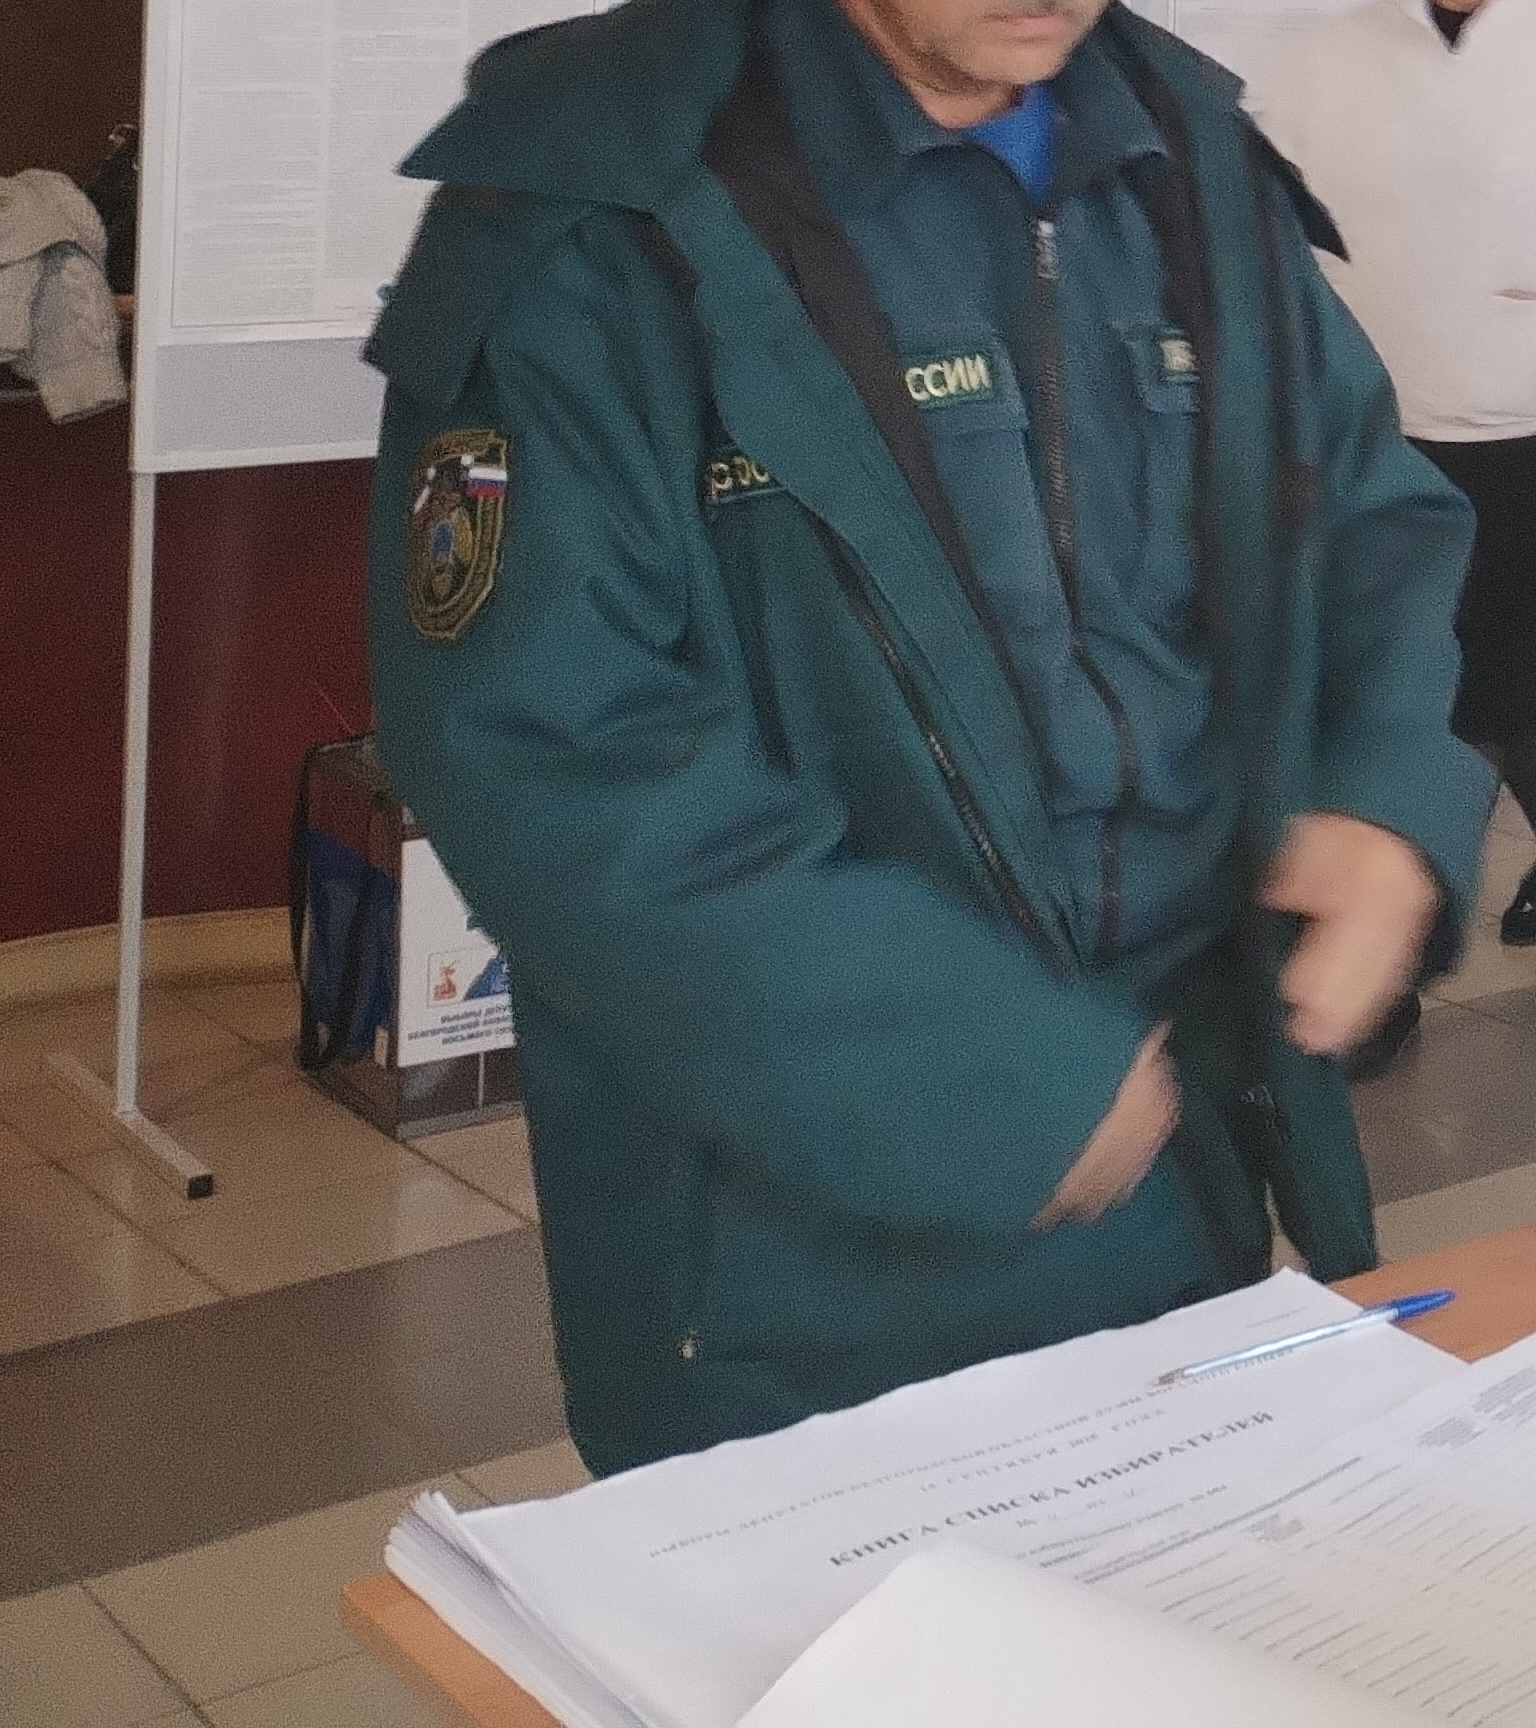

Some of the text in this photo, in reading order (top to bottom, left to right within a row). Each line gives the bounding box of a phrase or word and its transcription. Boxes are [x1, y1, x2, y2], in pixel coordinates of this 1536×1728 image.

[905, 354, 992, 401] ССИИ
[830, 1523, 938, 1567] КНИГА
[944, 1486, 1072, 1527] СПИСКА
[1074, 1410, 1275, 1489] ИЗБИРАТЕЛЕЙ
